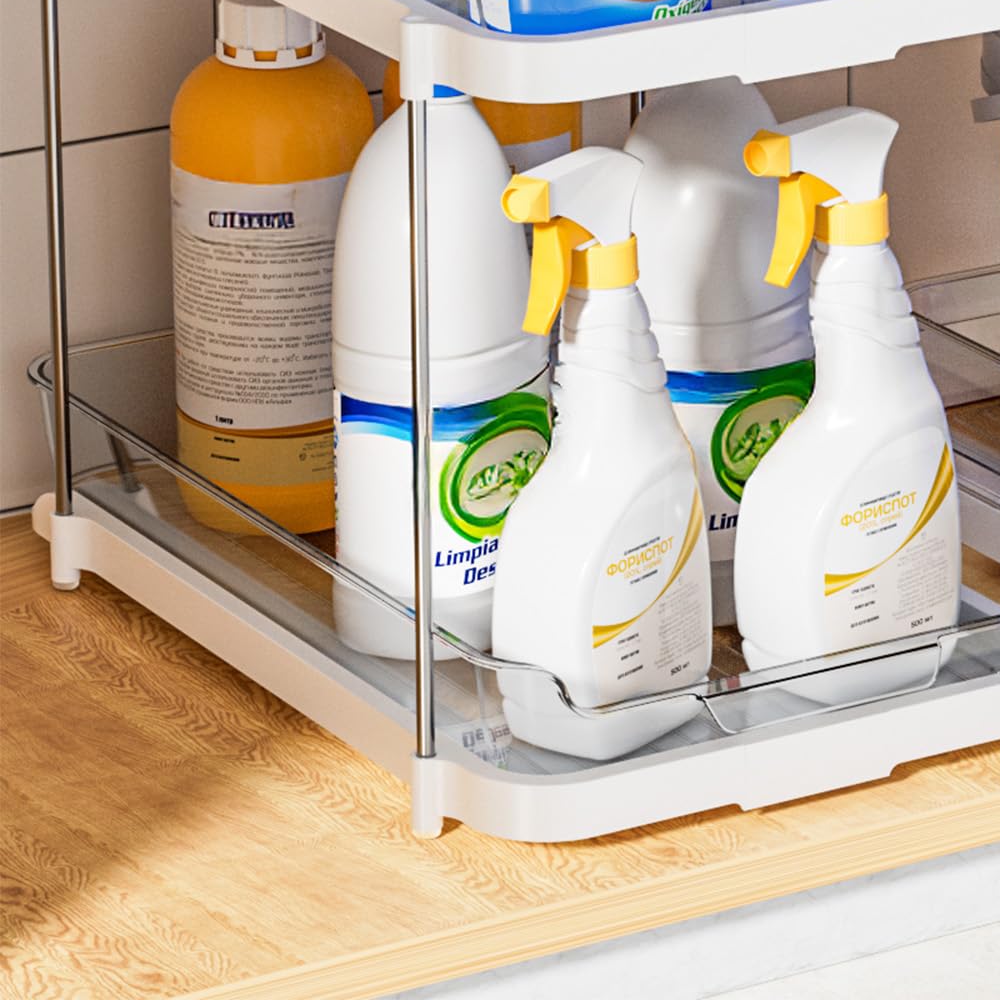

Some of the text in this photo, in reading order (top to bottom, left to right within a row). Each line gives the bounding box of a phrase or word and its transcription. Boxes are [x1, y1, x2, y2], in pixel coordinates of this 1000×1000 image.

[841, 491, 918, 527] ФОРИСПОТ
[434, 538, 499, 567] Limpia
[607, 536, 674, 577] ФОРИСПОТ
[463, 562, 497, 585] Des
